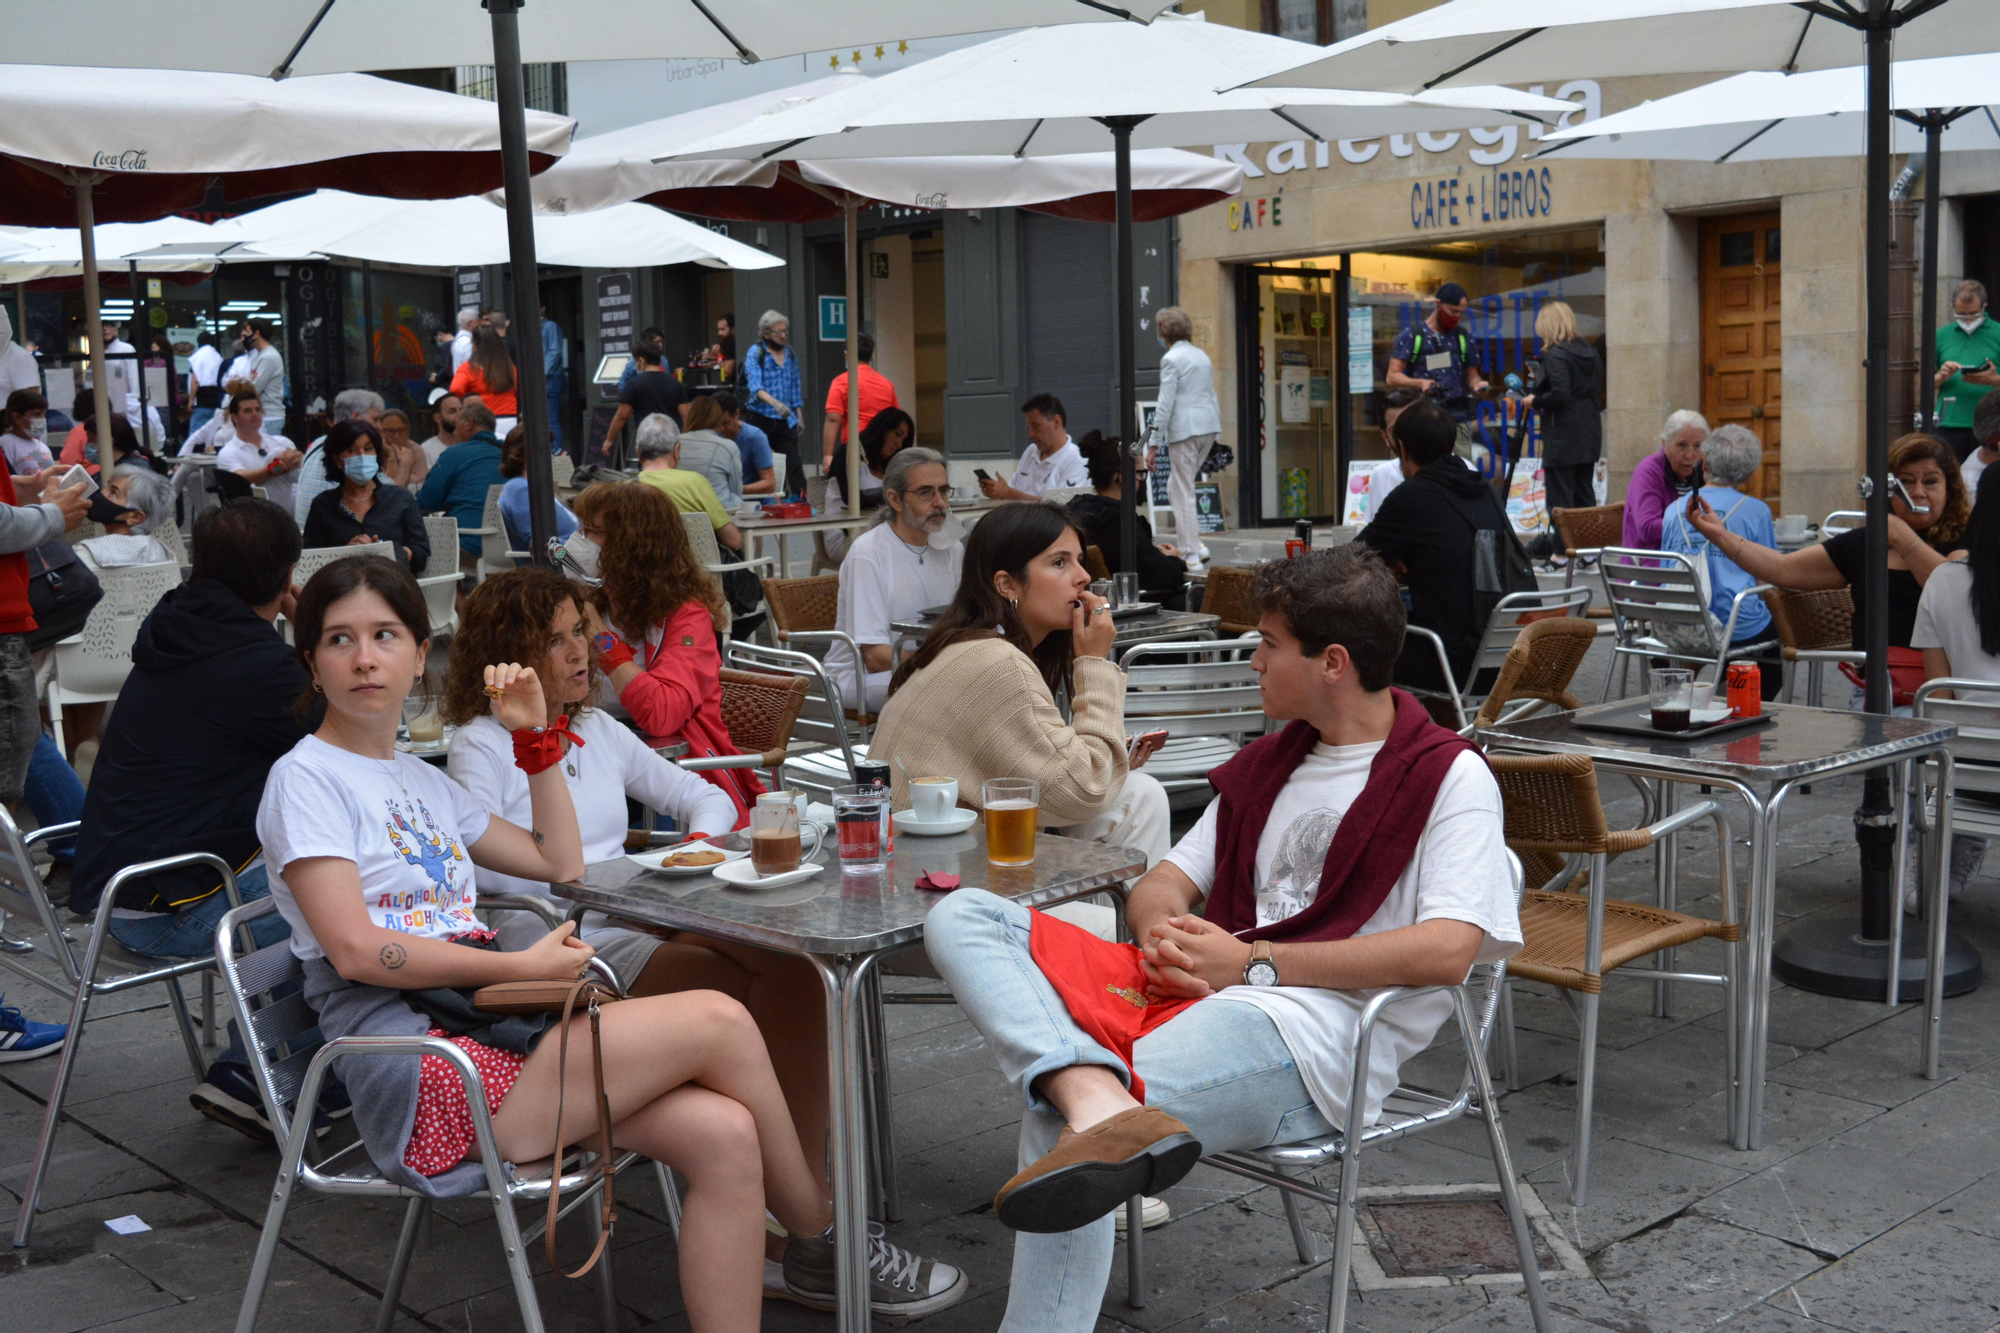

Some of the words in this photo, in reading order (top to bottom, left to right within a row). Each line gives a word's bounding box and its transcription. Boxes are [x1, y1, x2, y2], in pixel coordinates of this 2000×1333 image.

[93, 149, 148, 170] Coca-Cola
[1410, 165, 1463, 228] CAFÉ
[1228, 188, 1282, 231] CAFÉ
[1753, 261, 1764, 276] 5
[828, 303, 846, 325] H
[1282, 353, 1308, 363] CLOSED
[378, 886, 438, 911] ALCOHOL
